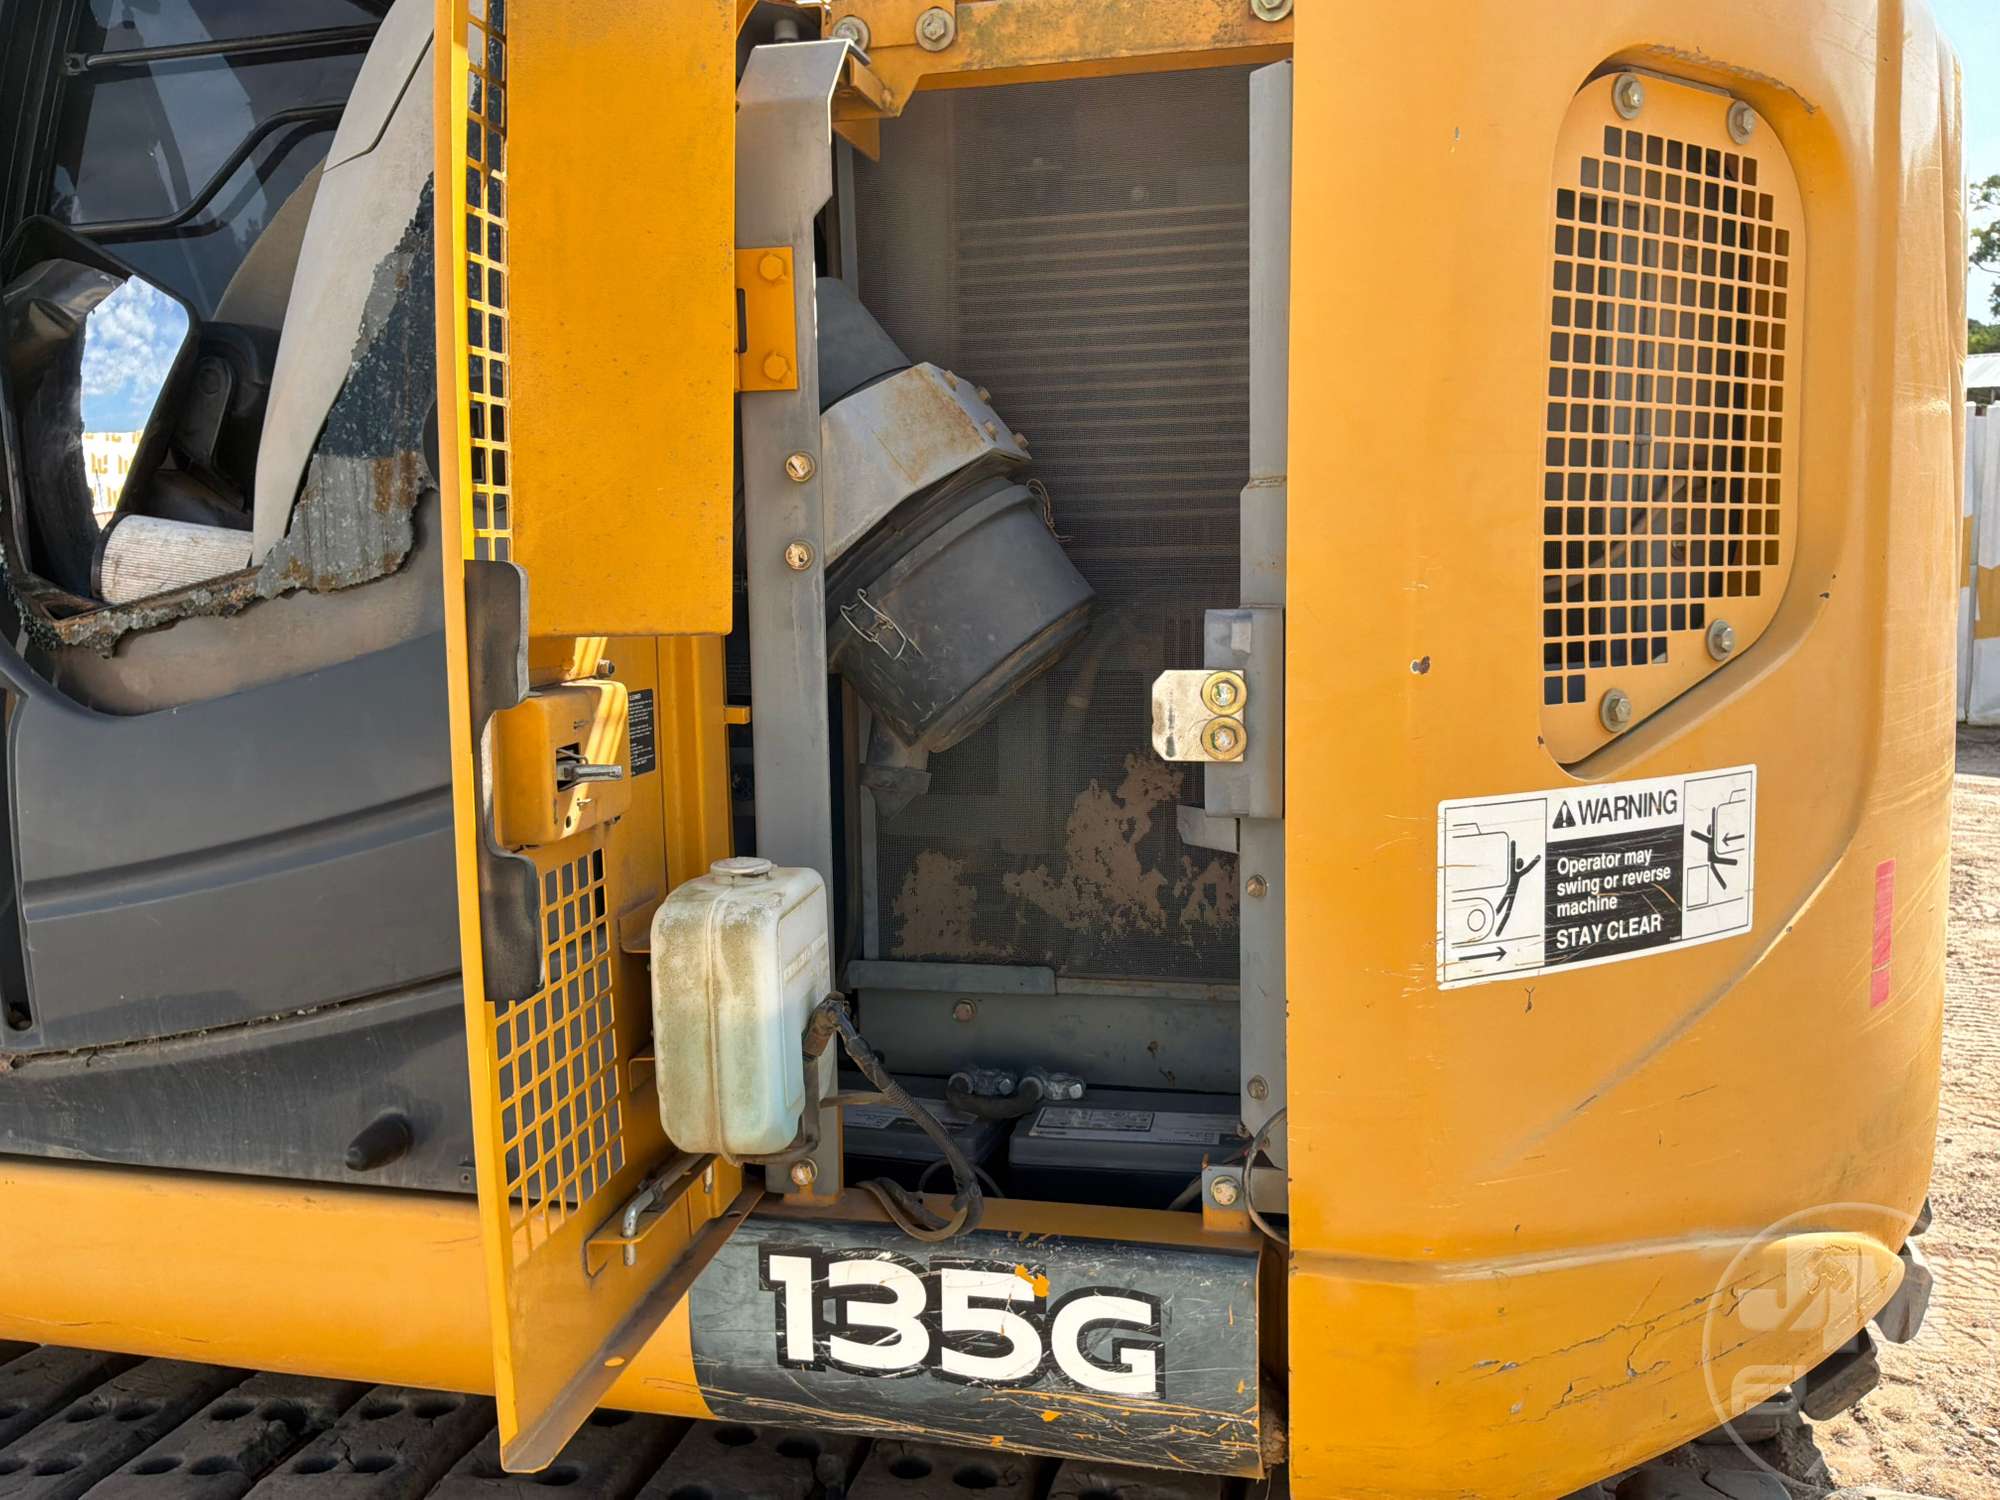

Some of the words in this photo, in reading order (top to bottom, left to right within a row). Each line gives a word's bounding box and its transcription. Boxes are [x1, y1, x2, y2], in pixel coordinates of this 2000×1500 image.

[1577, 789, 1677, 825] WARNING
[1557, 853, 1621, 876] Operator
[1624, 848, 1653, 868] may
[1556, 876, 1600, 897] swing
[1603, 875, 1620, 889] or
[1622, 866, 1671, 887] reverse
[1556, 895, 1618, 918] machine
[1555, 924, 1602, 950] STAY
[1606, 914, 1662, 942] CLEAR
[767, 1251, 1159, 1396] 135G
